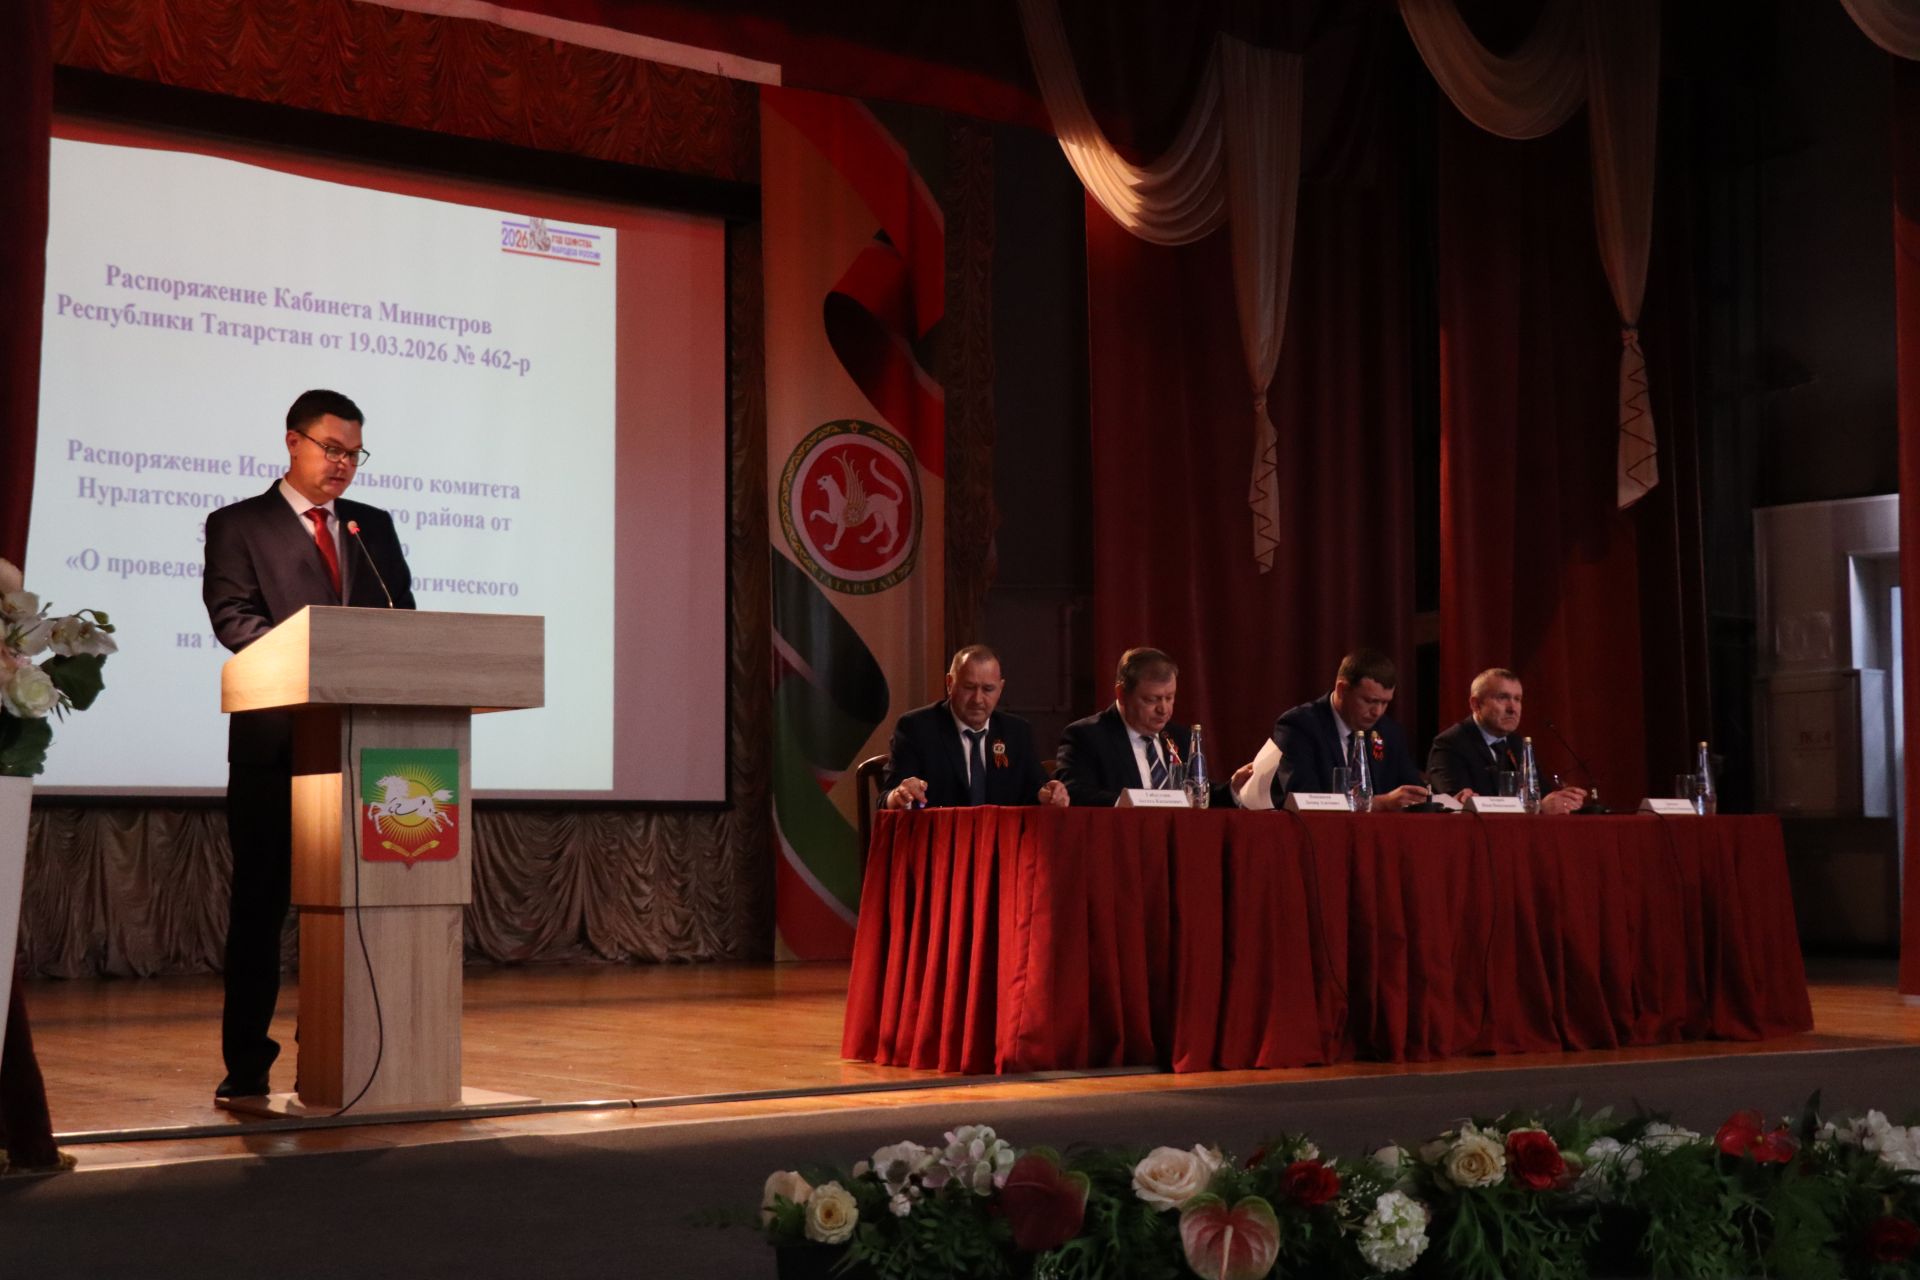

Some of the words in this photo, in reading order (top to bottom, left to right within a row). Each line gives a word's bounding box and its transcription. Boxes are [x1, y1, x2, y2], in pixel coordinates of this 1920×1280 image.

[502, 228, 528, 248] 2026
[105, 264, 268, 307] Распоряжение
[273, 287, 372, 321] Кабинета
[379, 301, 492, 337] Министров
[57, 293, 193, 332] Республики
[200, 312, 313, 347] Татарстан
[319, 333, 341, 351] от
[349, 331, 447, 363] 19.03.2026
[453, 343, 475, 366] №
[480, 347, 531, 375] 462-р
[67, 439, 232, 477] Распоряжение
[429, 478, 520, 500] комитета
[78, 476, 224, 510] Нурлатского
[416, 508, 485, 533] района
[491, 514, 512, 533] от
[66, 549, 100, 573] «О
[176, 630, 202, 649] на
